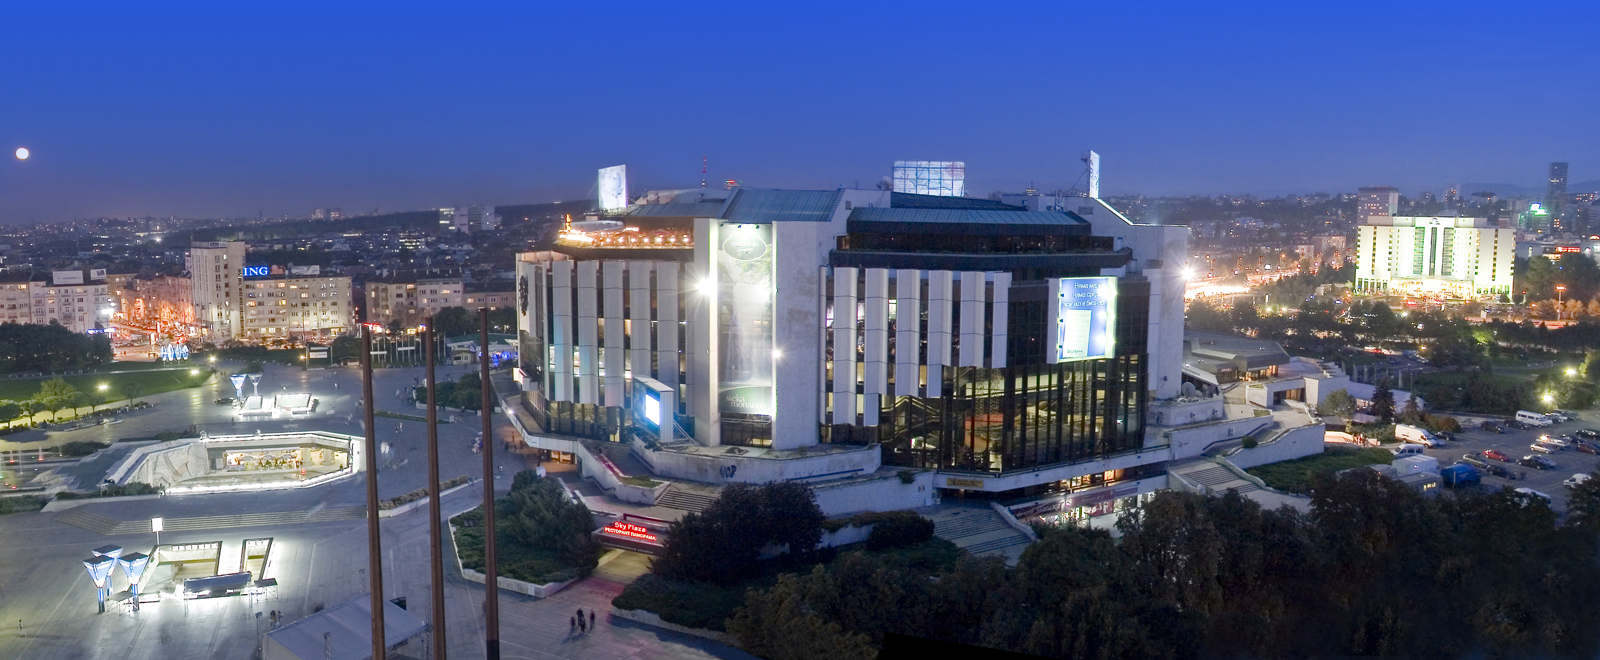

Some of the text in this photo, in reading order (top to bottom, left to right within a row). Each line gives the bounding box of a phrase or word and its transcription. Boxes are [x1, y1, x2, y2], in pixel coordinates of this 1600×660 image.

[244, 266, 268, 276] ING
[614, 521, 646, 532] Sky Plaza
